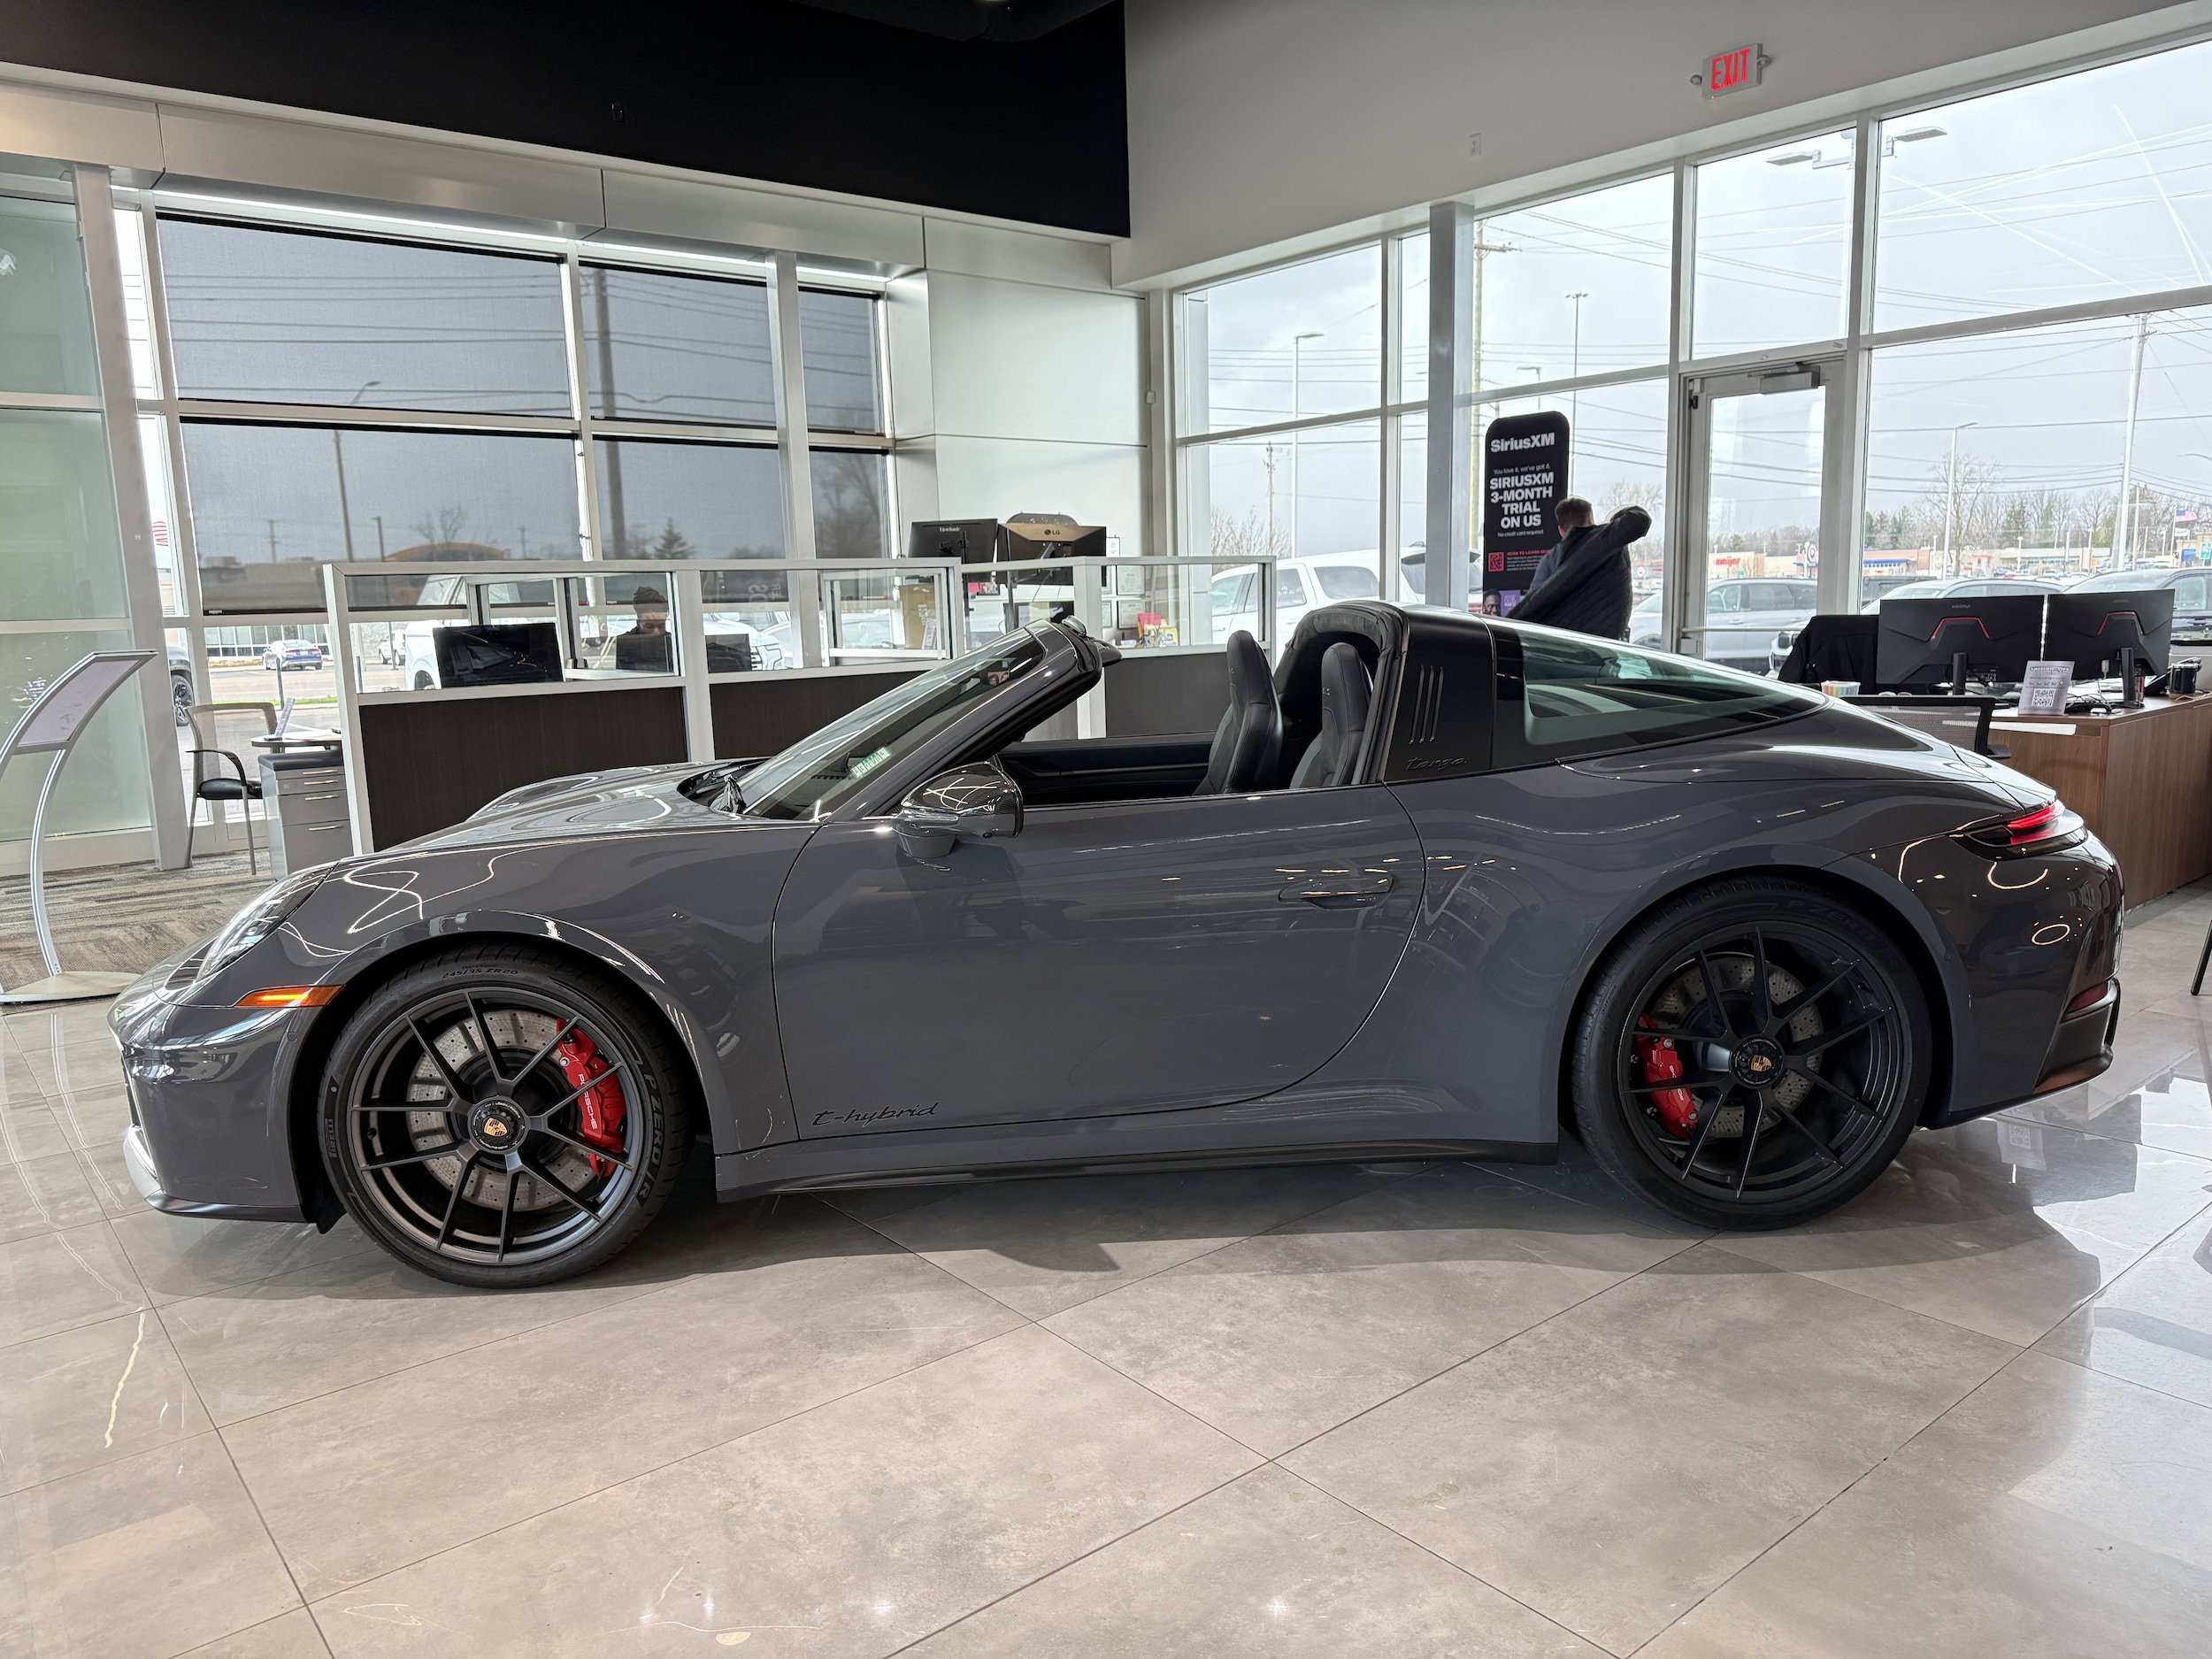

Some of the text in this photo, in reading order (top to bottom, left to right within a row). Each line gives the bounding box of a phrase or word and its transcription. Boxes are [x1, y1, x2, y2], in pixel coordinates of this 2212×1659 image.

[1711, 48, 1751, 90] EXIT
[1490, 432, 1555, 453] SiriusXM
[1489, 472, 1555, 490] SIRIUSXM
[1490, 486, 1554, 503] 3-MONTH
[1502, 501, 1540, 515] TRIAL
[1501, 514, 1542, 529] ON US
[643, 1073, 657, 1090] P
[650, 1094, 665, 1166] ZERO
[811, 1101, 941, 1128] t-hybrid
